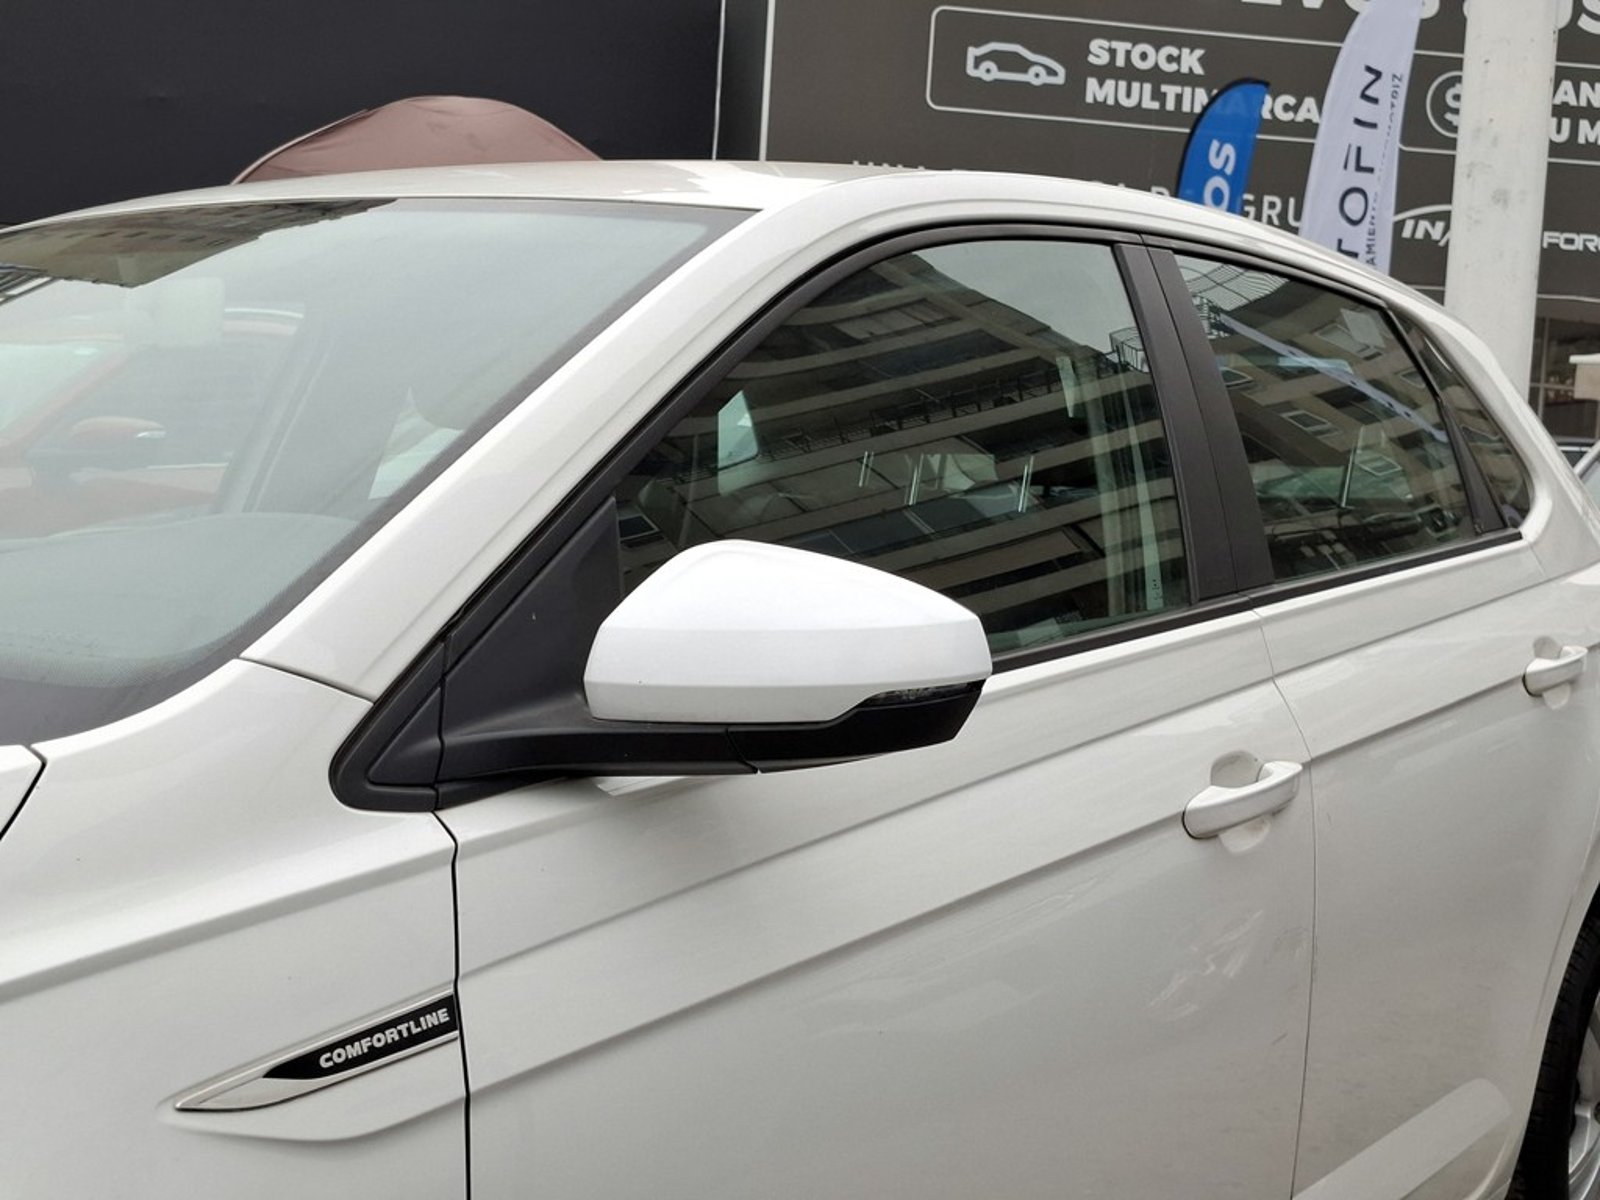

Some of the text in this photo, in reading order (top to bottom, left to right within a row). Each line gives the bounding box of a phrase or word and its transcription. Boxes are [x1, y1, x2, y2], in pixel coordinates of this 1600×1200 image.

[1087, 38, 1206, 75] STOCK
[1542, 230, 1600, 252] FOR
[319, 1007, 451, 1069] COMFORTLINE
